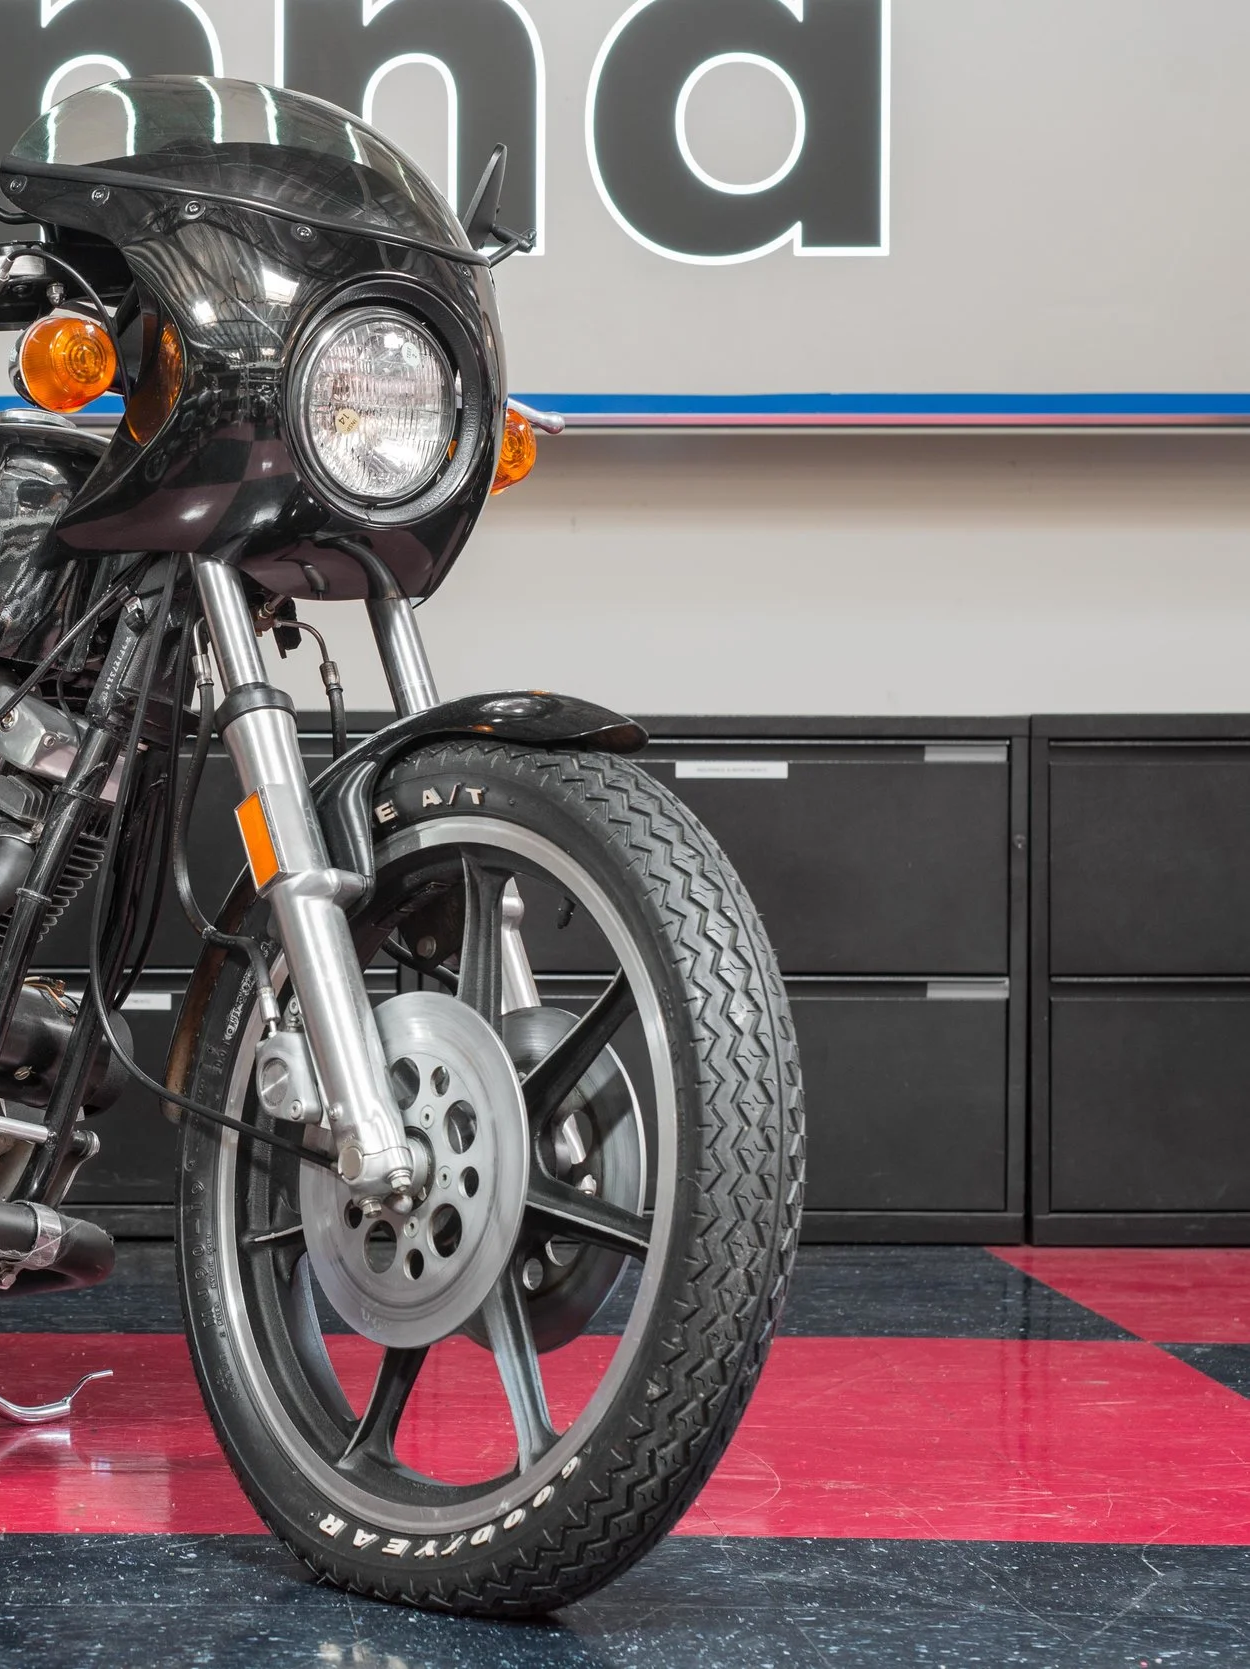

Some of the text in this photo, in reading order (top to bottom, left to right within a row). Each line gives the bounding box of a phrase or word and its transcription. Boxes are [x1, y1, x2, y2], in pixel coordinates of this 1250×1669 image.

[338, 413, 349, 425] 14
[422, 782, 486, 808] A/T
[318, 1456, 581, 1558] GOODYEAR
